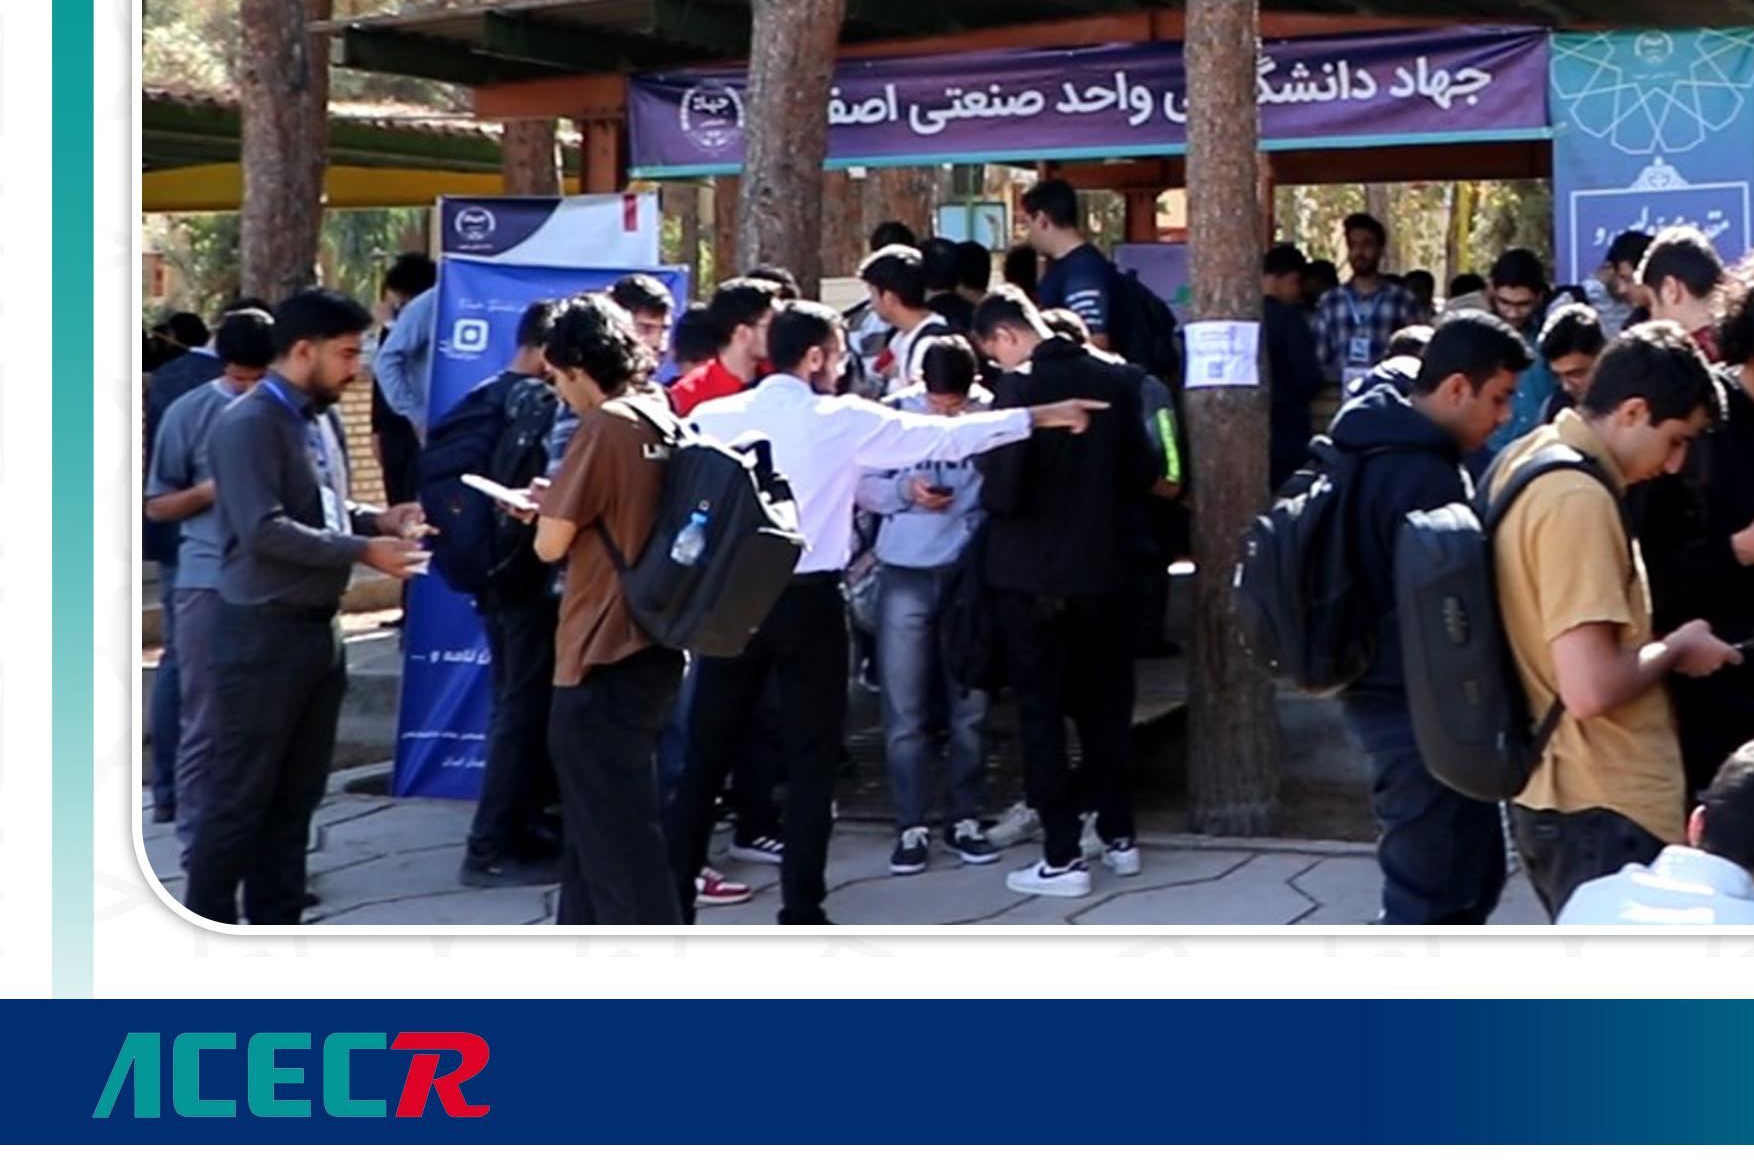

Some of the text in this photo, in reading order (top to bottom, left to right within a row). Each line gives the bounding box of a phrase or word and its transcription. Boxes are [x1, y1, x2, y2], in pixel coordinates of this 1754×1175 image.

[908, 79, 1045, 136] صنعتی
[1055, 70, 1152, 126] واحد
[1389, 53, 1493, 108] جهاد
